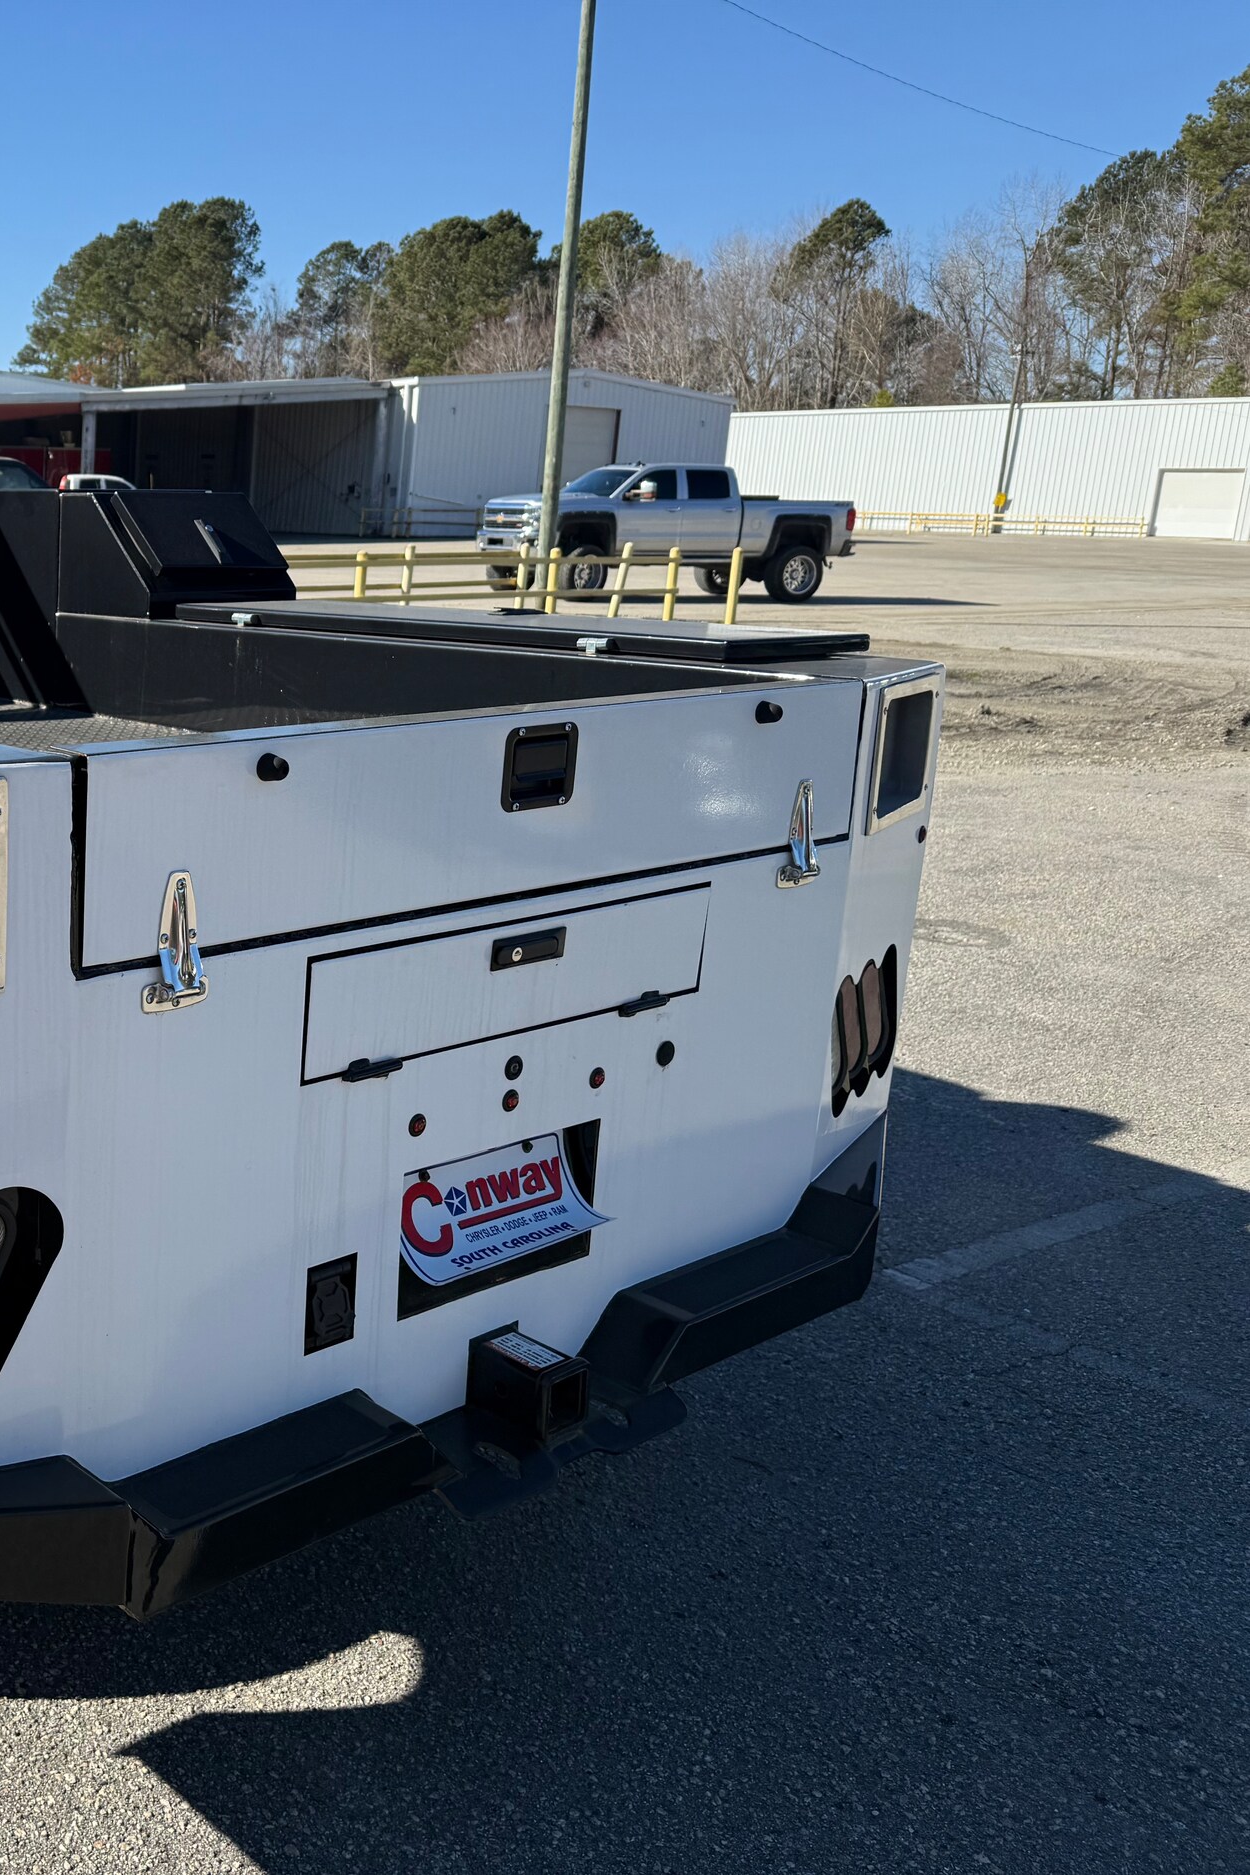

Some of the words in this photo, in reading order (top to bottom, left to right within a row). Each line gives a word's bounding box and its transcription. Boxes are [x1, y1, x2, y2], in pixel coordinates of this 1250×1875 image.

[450, 1245, 503, 1268] SOUTH
[502, 1221, 575, 1249] CAROLINA
[465, 1224, 501, 1243] CHRYSLER
[503, 1216, 529, 1232] DODGE
[531, 1210, 548, 1223] JEEP
[552, 1204, 568, 1217] RAM
